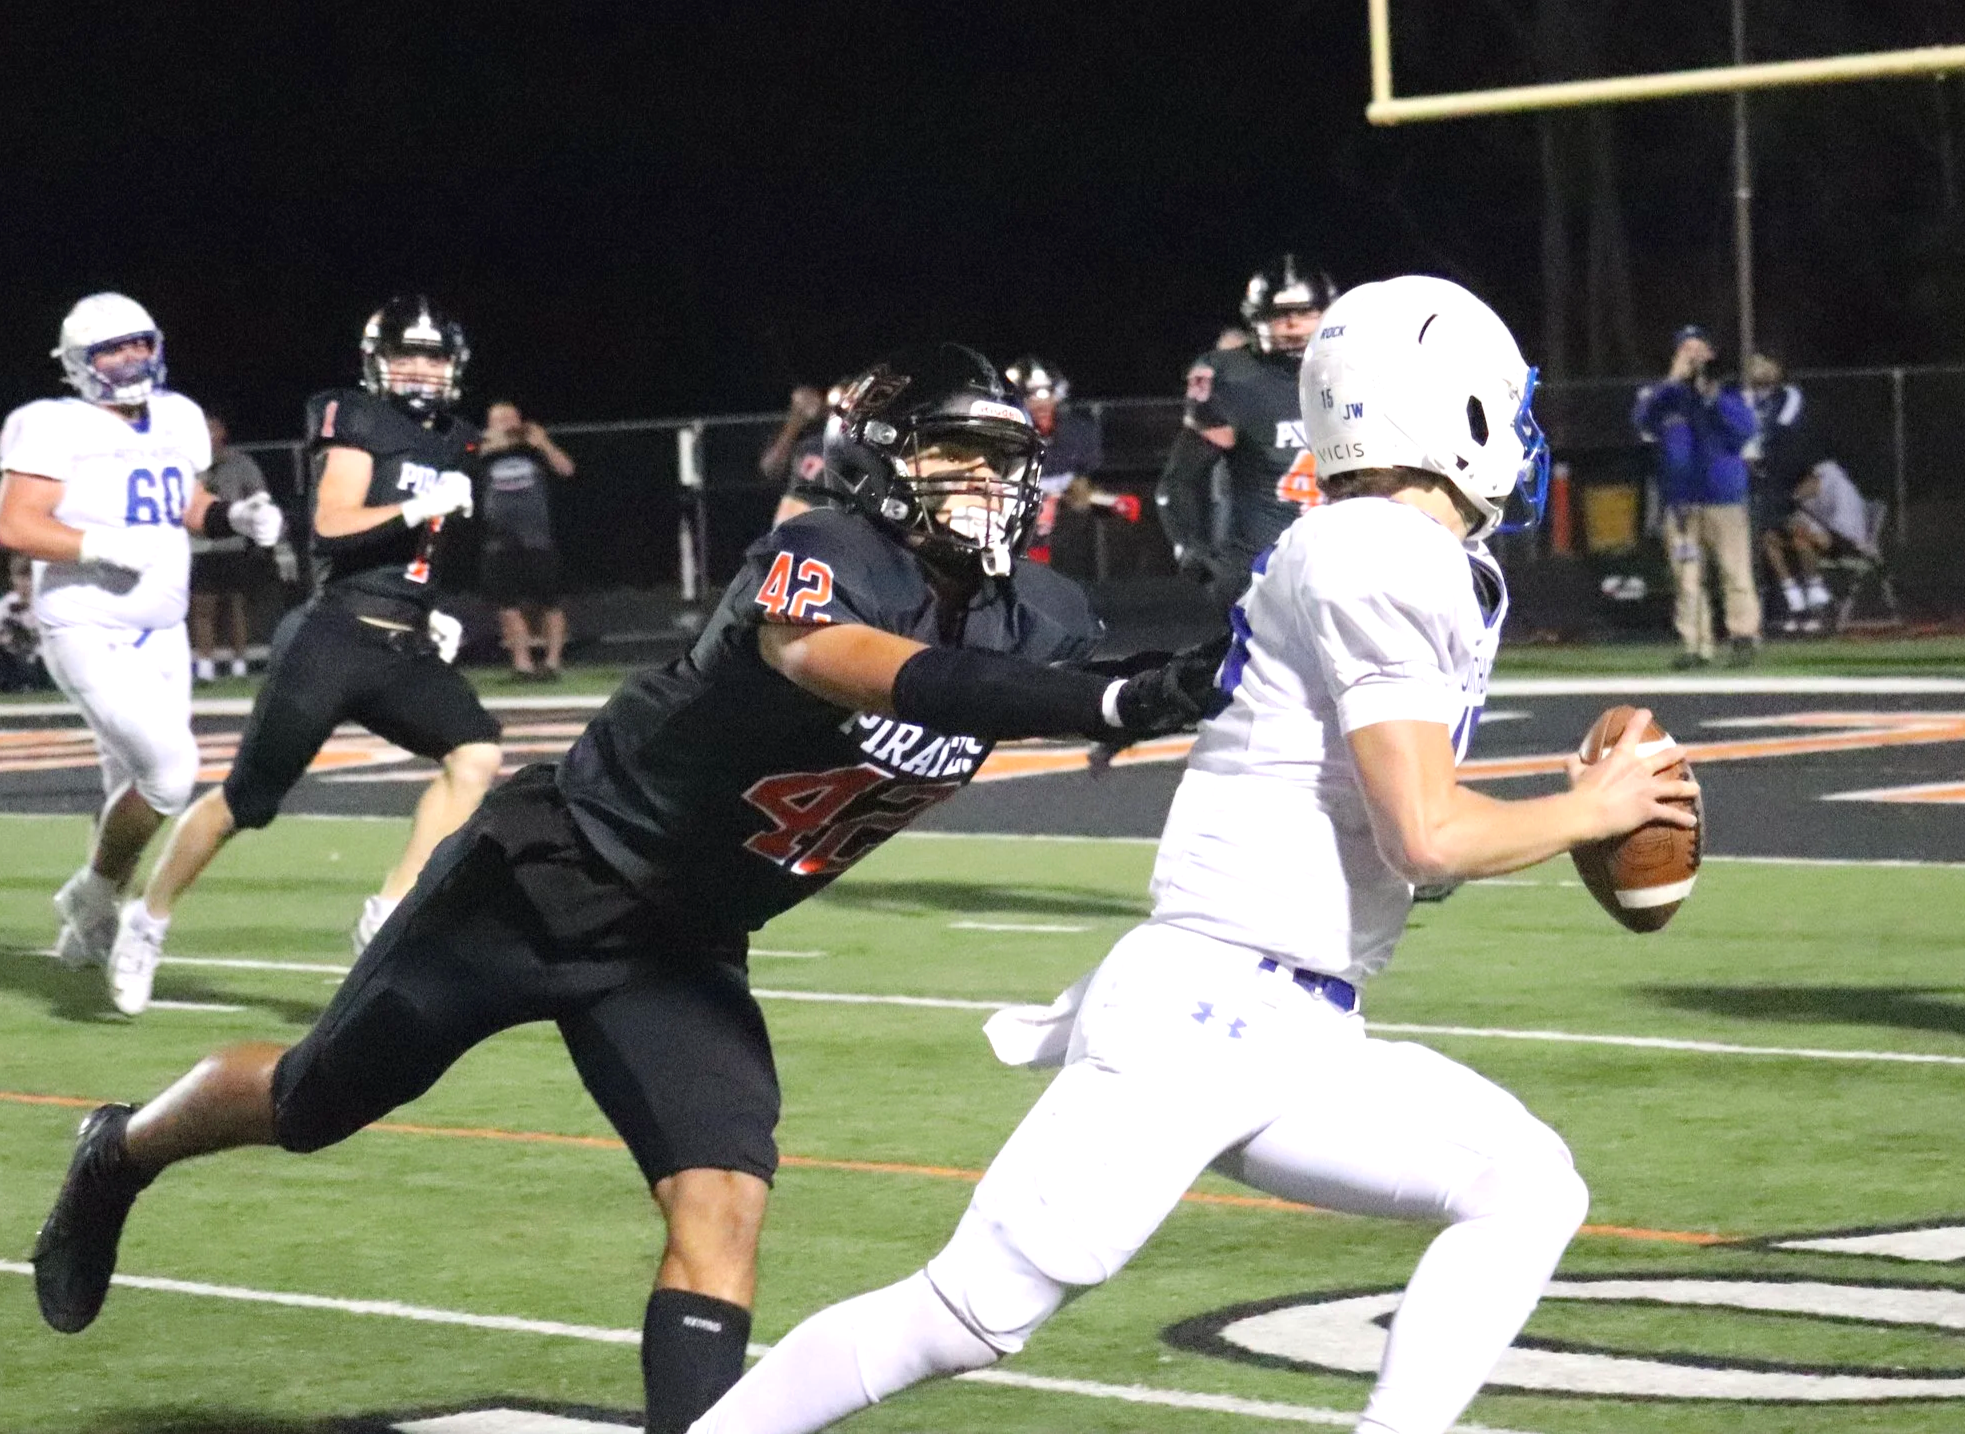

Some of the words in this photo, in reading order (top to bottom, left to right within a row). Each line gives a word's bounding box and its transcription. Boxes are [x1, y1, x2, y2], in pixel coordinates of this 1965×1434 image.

[1321, 388, 1334, 409] 15
[1343, 402, 1363, 421] JW
[1317, 442, 1365, 463] VICIS
[124, 467, 184, 526] 60
[755, 551, 834, 623] 42
[741, 762, 960, 876] 42
